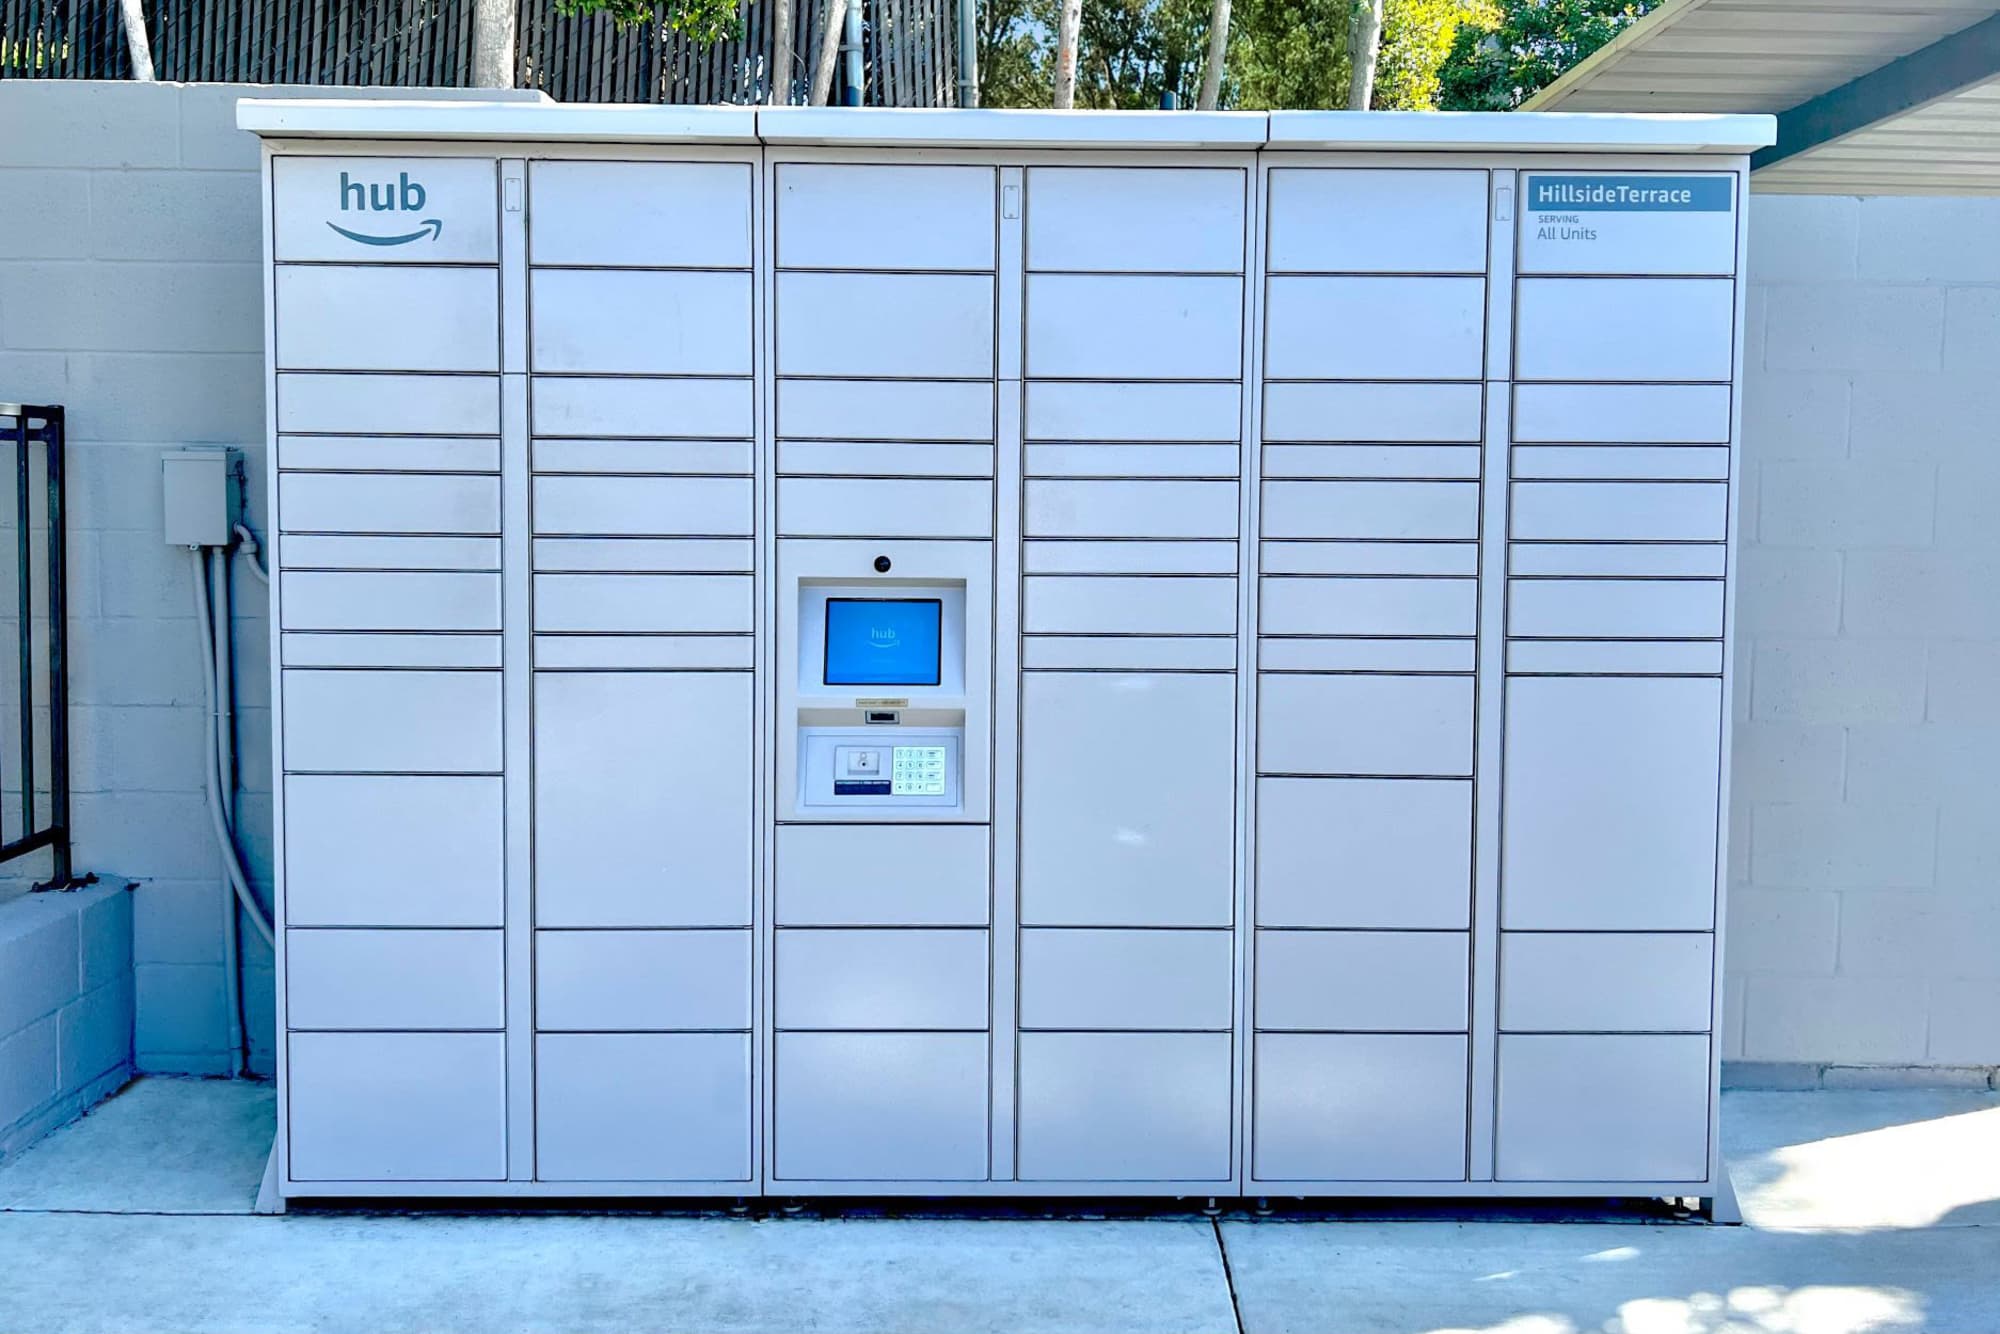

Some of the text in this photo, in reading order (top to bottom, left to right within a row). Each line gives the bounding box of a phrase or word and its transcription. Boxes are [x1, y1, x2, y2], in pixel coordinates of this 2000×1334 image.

[340, 172, 426, 211] hub
[1539, 185, 1691, 203] HillsideTerrace
[1538, 214, 1579, 224] SERVING
[1537, 227, 1597, 240] All Units
[871, 626, 896, 639] hub
